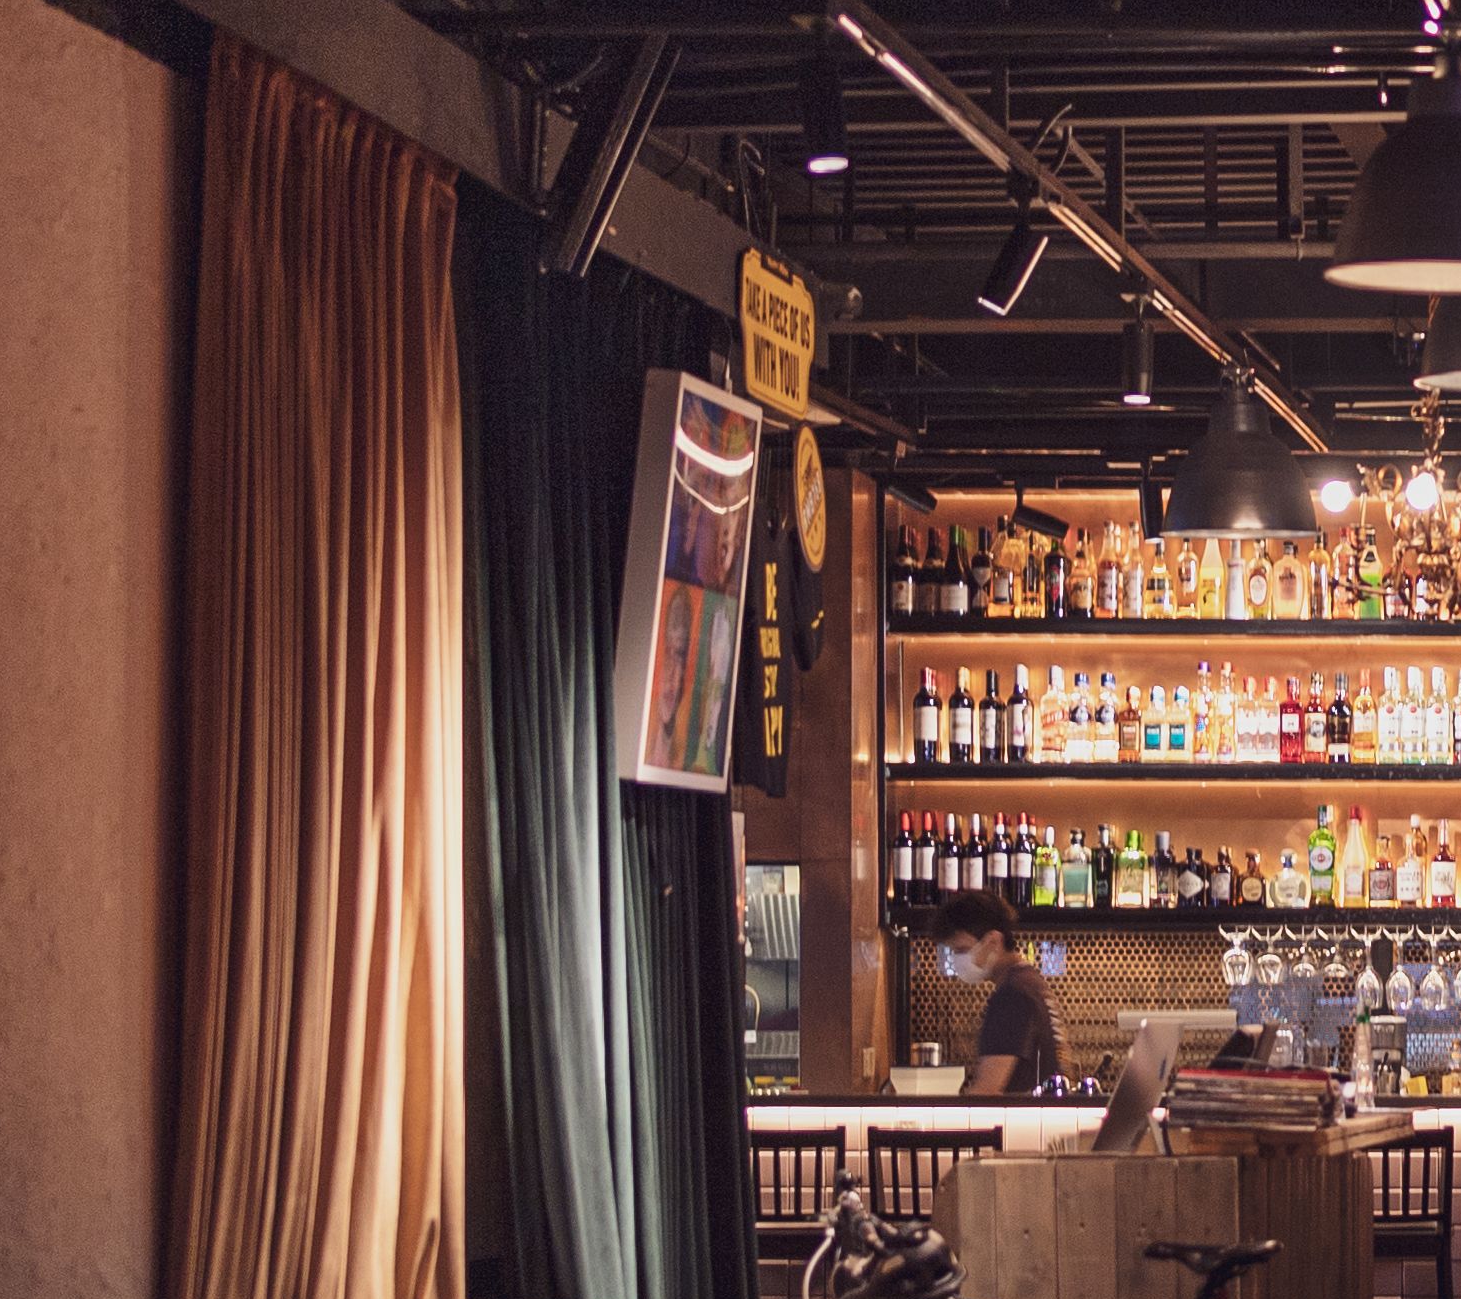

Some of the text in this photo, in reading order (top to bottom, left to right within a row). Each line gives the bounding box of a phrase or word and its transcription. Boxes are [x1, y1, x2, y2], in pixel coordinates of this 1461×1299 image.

[746, 276, 811, 351] TAKE A PIECE OF US
[753, 331, 800, 402] WITH YOU!
